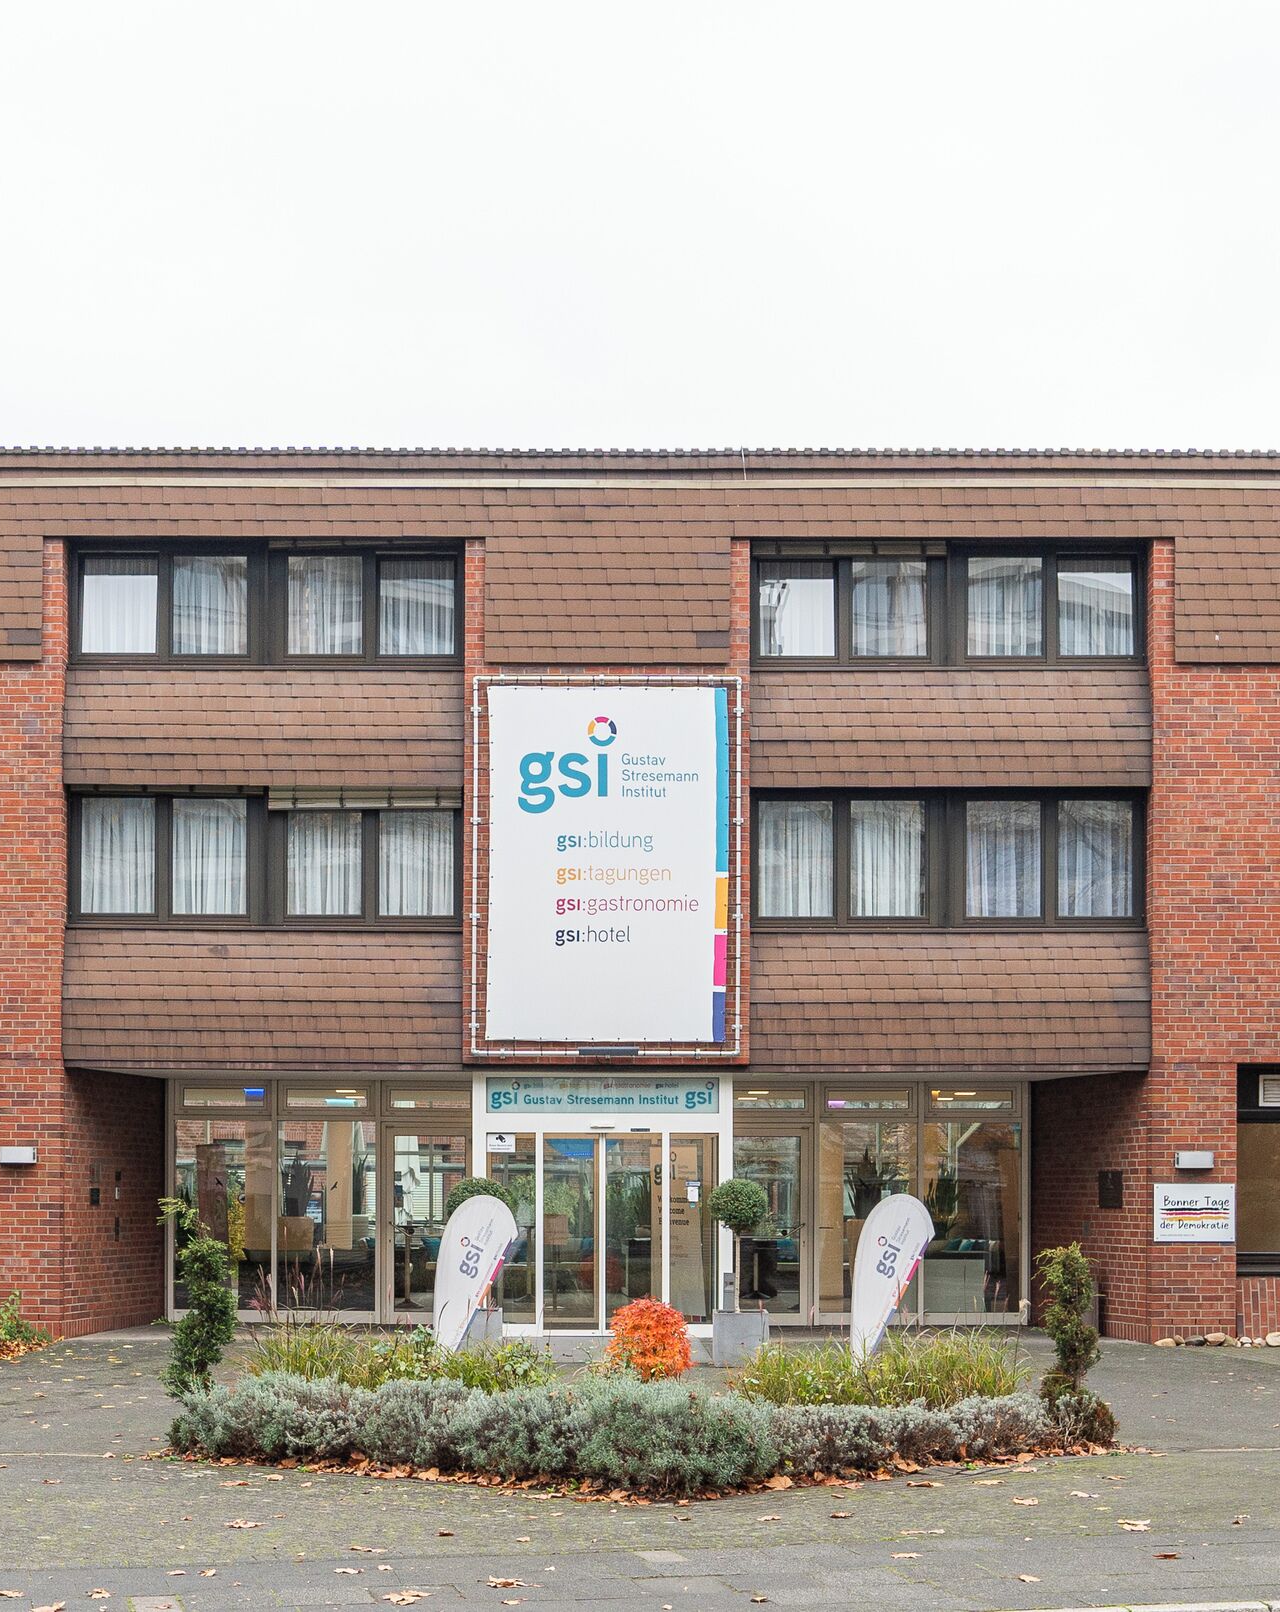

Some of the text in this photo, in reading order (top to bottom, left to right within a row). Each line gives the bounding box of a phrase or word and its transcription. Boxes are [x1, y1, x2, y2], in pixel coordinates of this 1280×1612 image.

[517, 716, 618, 814] gsi
[621, 752, 666, 766] Gustav
[621, 769, 699, 782] Stresemann
[621, 785, 667, 798] Institut
[491, 1081, 521, 1110] gsi
[523, 1094, 562, 1105] Gustav
[567, 1094, 635, 1105] Stresemann
[638, 1094, 679, 1105] Institut
[684, 1081, 715, 1110] gsi
[654, 1152, 677, 1185] gi
[1163, 1195, 1230, 1210] Bonner Tage
[1160, 1219, 1229, 1230] der Demokratie
[459, 1236, 484, 1279] gsi
[876, 1236, 902, 1279] gsi
